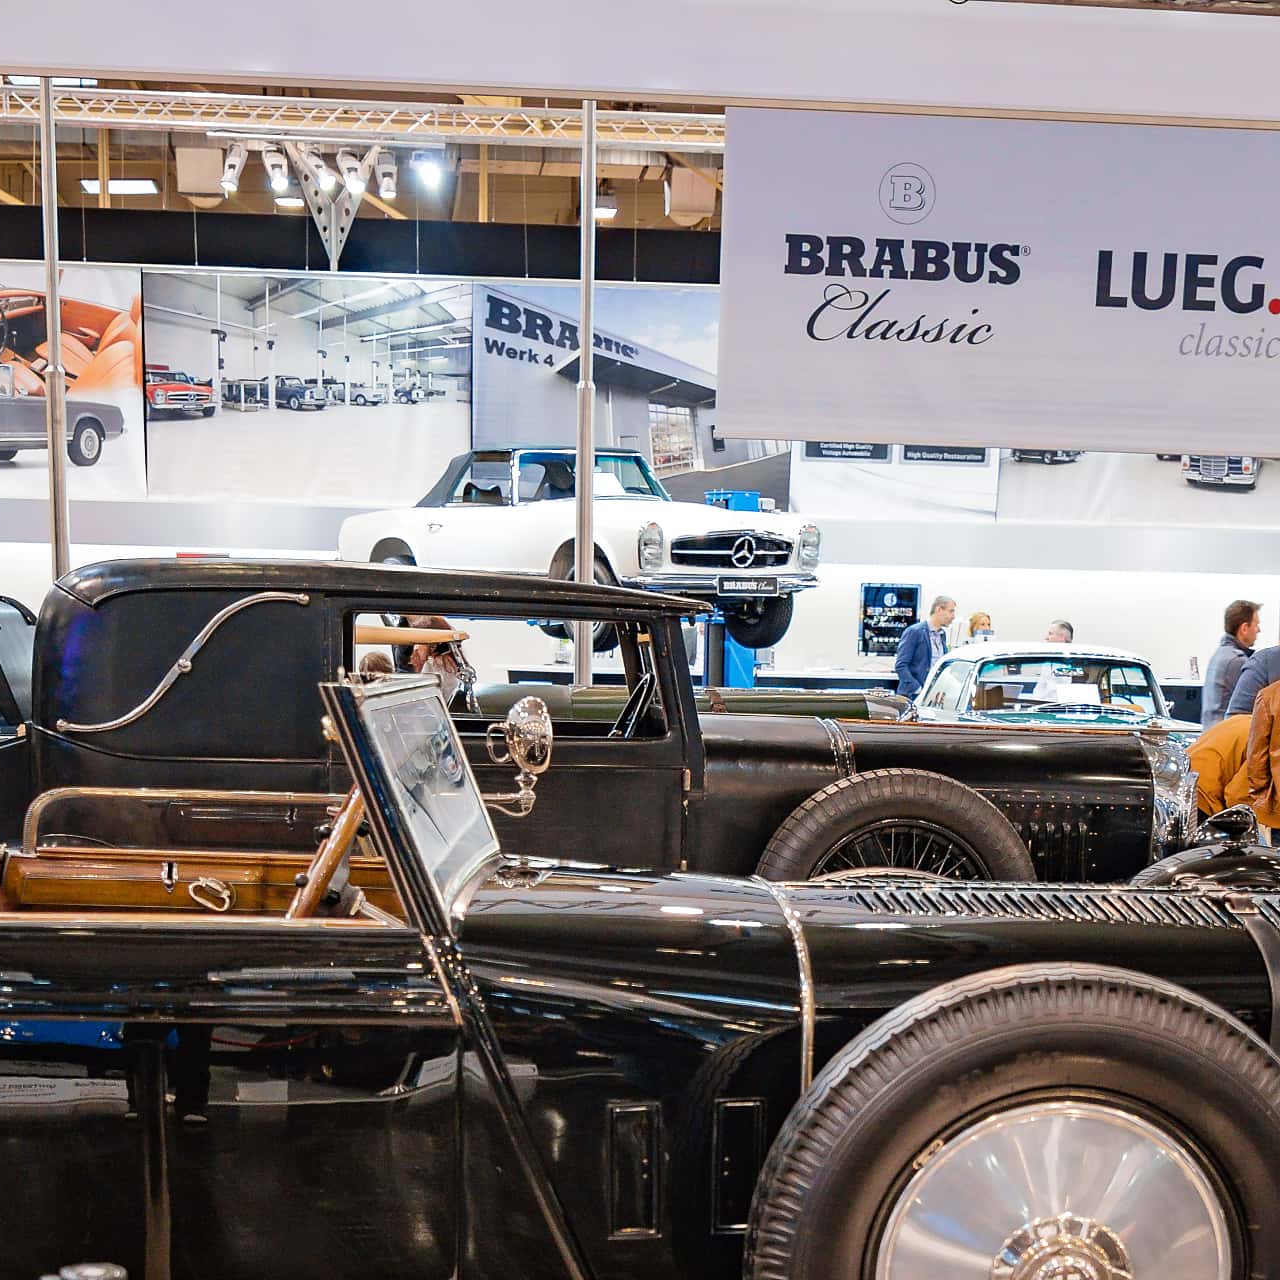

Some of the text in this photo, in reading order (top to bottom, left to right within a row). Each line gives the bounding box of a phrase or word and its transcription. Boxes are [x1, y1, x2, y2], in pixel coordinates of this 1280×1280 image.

[805, 282, 994, 347] Classic
[484, 337, 555, 368] Werk 4
